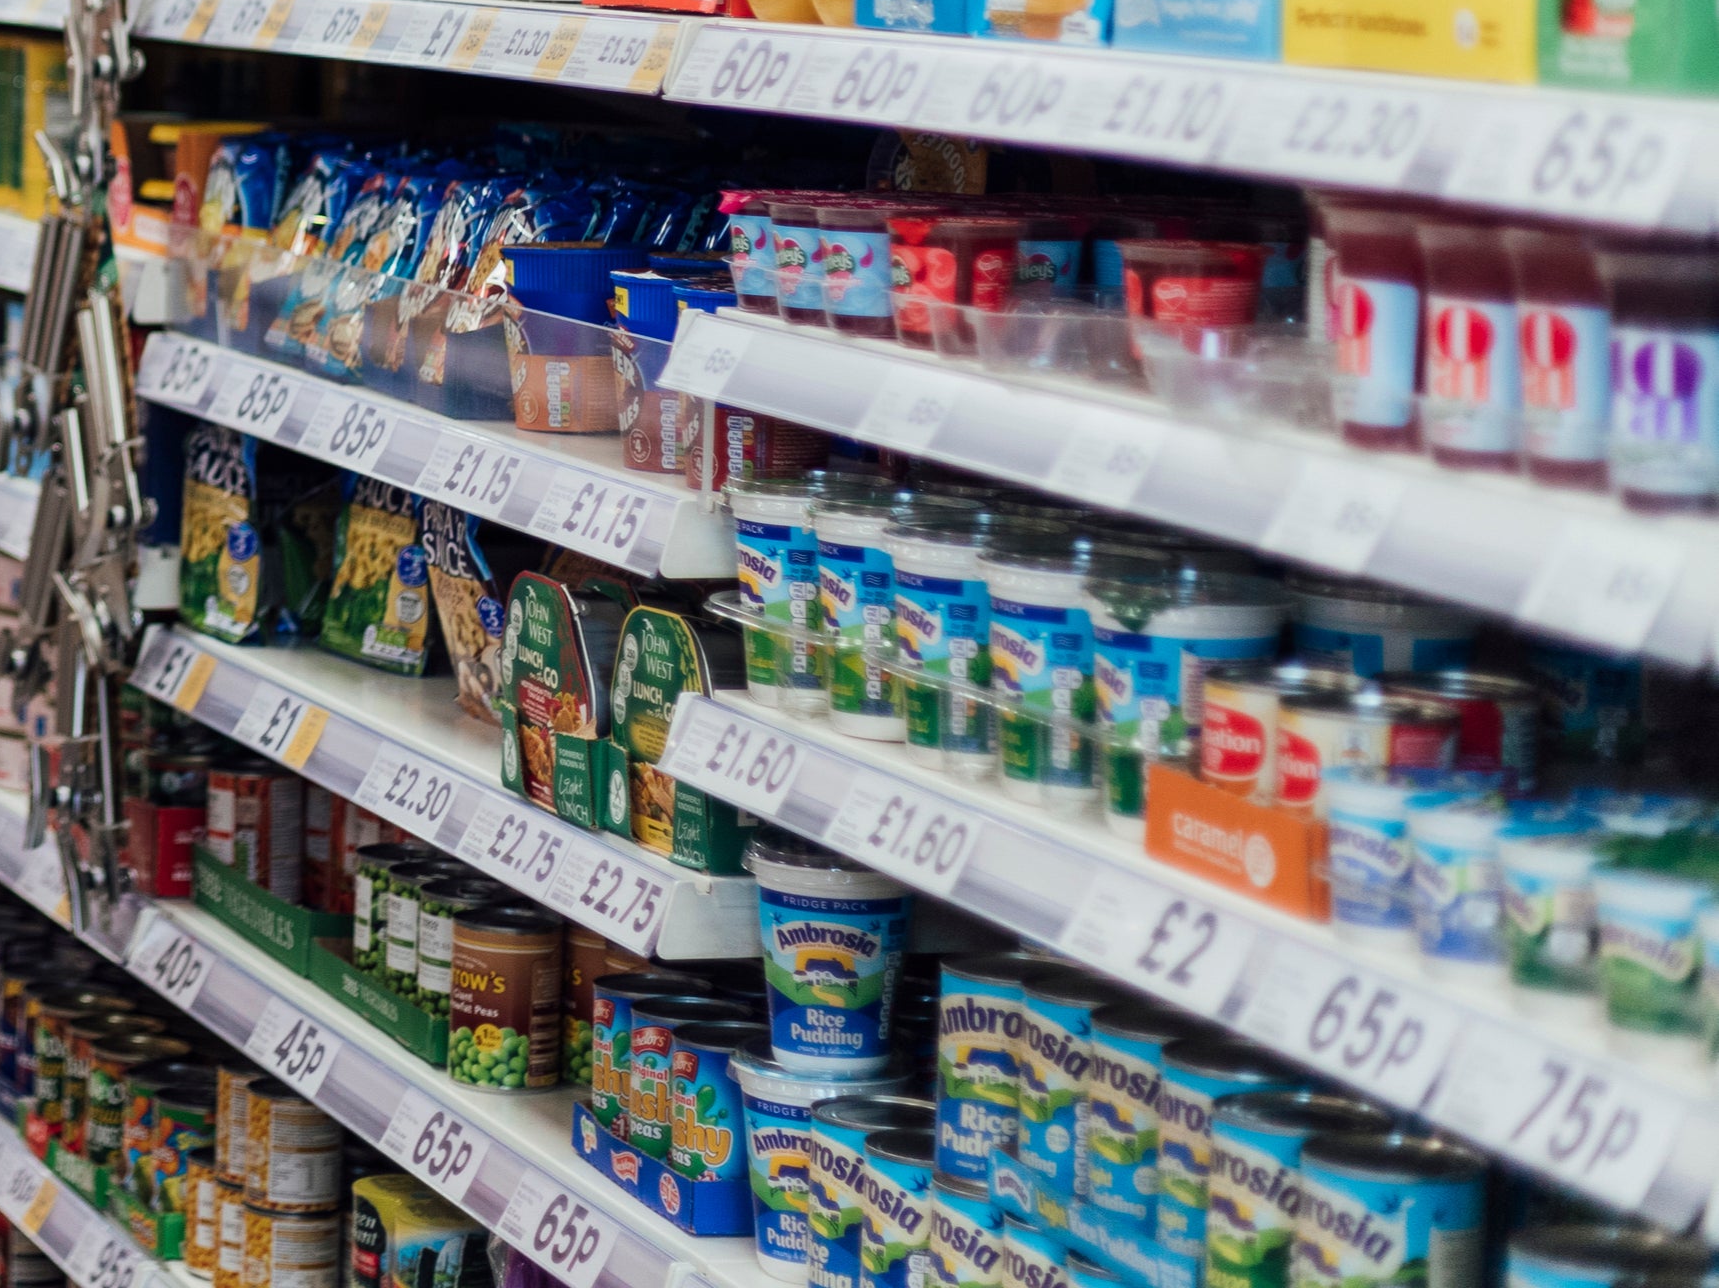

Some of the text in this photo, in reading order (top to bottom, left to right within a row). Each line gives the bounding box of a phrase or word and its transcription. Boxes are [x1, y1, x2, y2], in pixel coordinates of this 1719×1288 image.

[323, 8, 360, 43] 67p
[421, 9, 468, 57] £1
[504, 28, 551, 57] £1.30
[598, 35, 647, 66] £1.50
[711, 39, 790, 100] 60p
[832, 47, 919, 110] 60p
[967, 58, 1067, 124] 60p
[1102, 75, 1226, 142] £1.10
[1285, 97, 1419, 162] £2.30
[1532, 109, 1666, 199] 65p
[162, 345, 210, 397] 85p
[237, 373, 289, 427] 85p
[330, 402, 386, 461] 85p
[443, 445, 520, 505] £1.15
[562, 483, 647, 548] £1.15
[741, 523, 764, 535] PACK
[900, 573, 923, 586] PACK
[524, 596, 549, 624] JOHN
[528, 619, 553, 647] WEST
[518, 644, 543, 670] LUNCH
[641, 629, 670, 656] JOHN
[645, 653, 674, 681] WEST
[154, 646, 183, 695] £1
[543, 666, 558, 689] GO
[633, 680, 663, 706] LUNCH
[259, 697, 292, 750] £1
[705, 724, 797, 795] £1.60
[384, 763, 452, 823] £2.30
[487, 814, 564, 886] £2.75
[867, 795, 969, 876] £1.60
[1172, 812, 1245, 854] caramel
[579, 859, 663, 934] £2.75
[783, 895, 868, 912] FRIDGE PACK
[776, 922, 879, 958] Ambrosia
[1136, 900, 1219, 988] £2
[154, 937, 203, 996] 40p
[474, 1006, 499, 1020] Peas
[790, 1023, 863, 1047] Pudding
[806, 1007, 846, 1028] Rice
[1307, 975, 1427, 1084] 65p
[274, 1018, 325, 1082] 45p
[631, 1120, 663, 1140] peas
[757, 1100, 797, 1117] FRIDGE
[961, 1103, 1019, 1135] Rice
[1508, 1058, 1644, 1178] 75p
[412, 1111, 473, 1183] 65p
[533, 1193, 601, 1270] 65p
